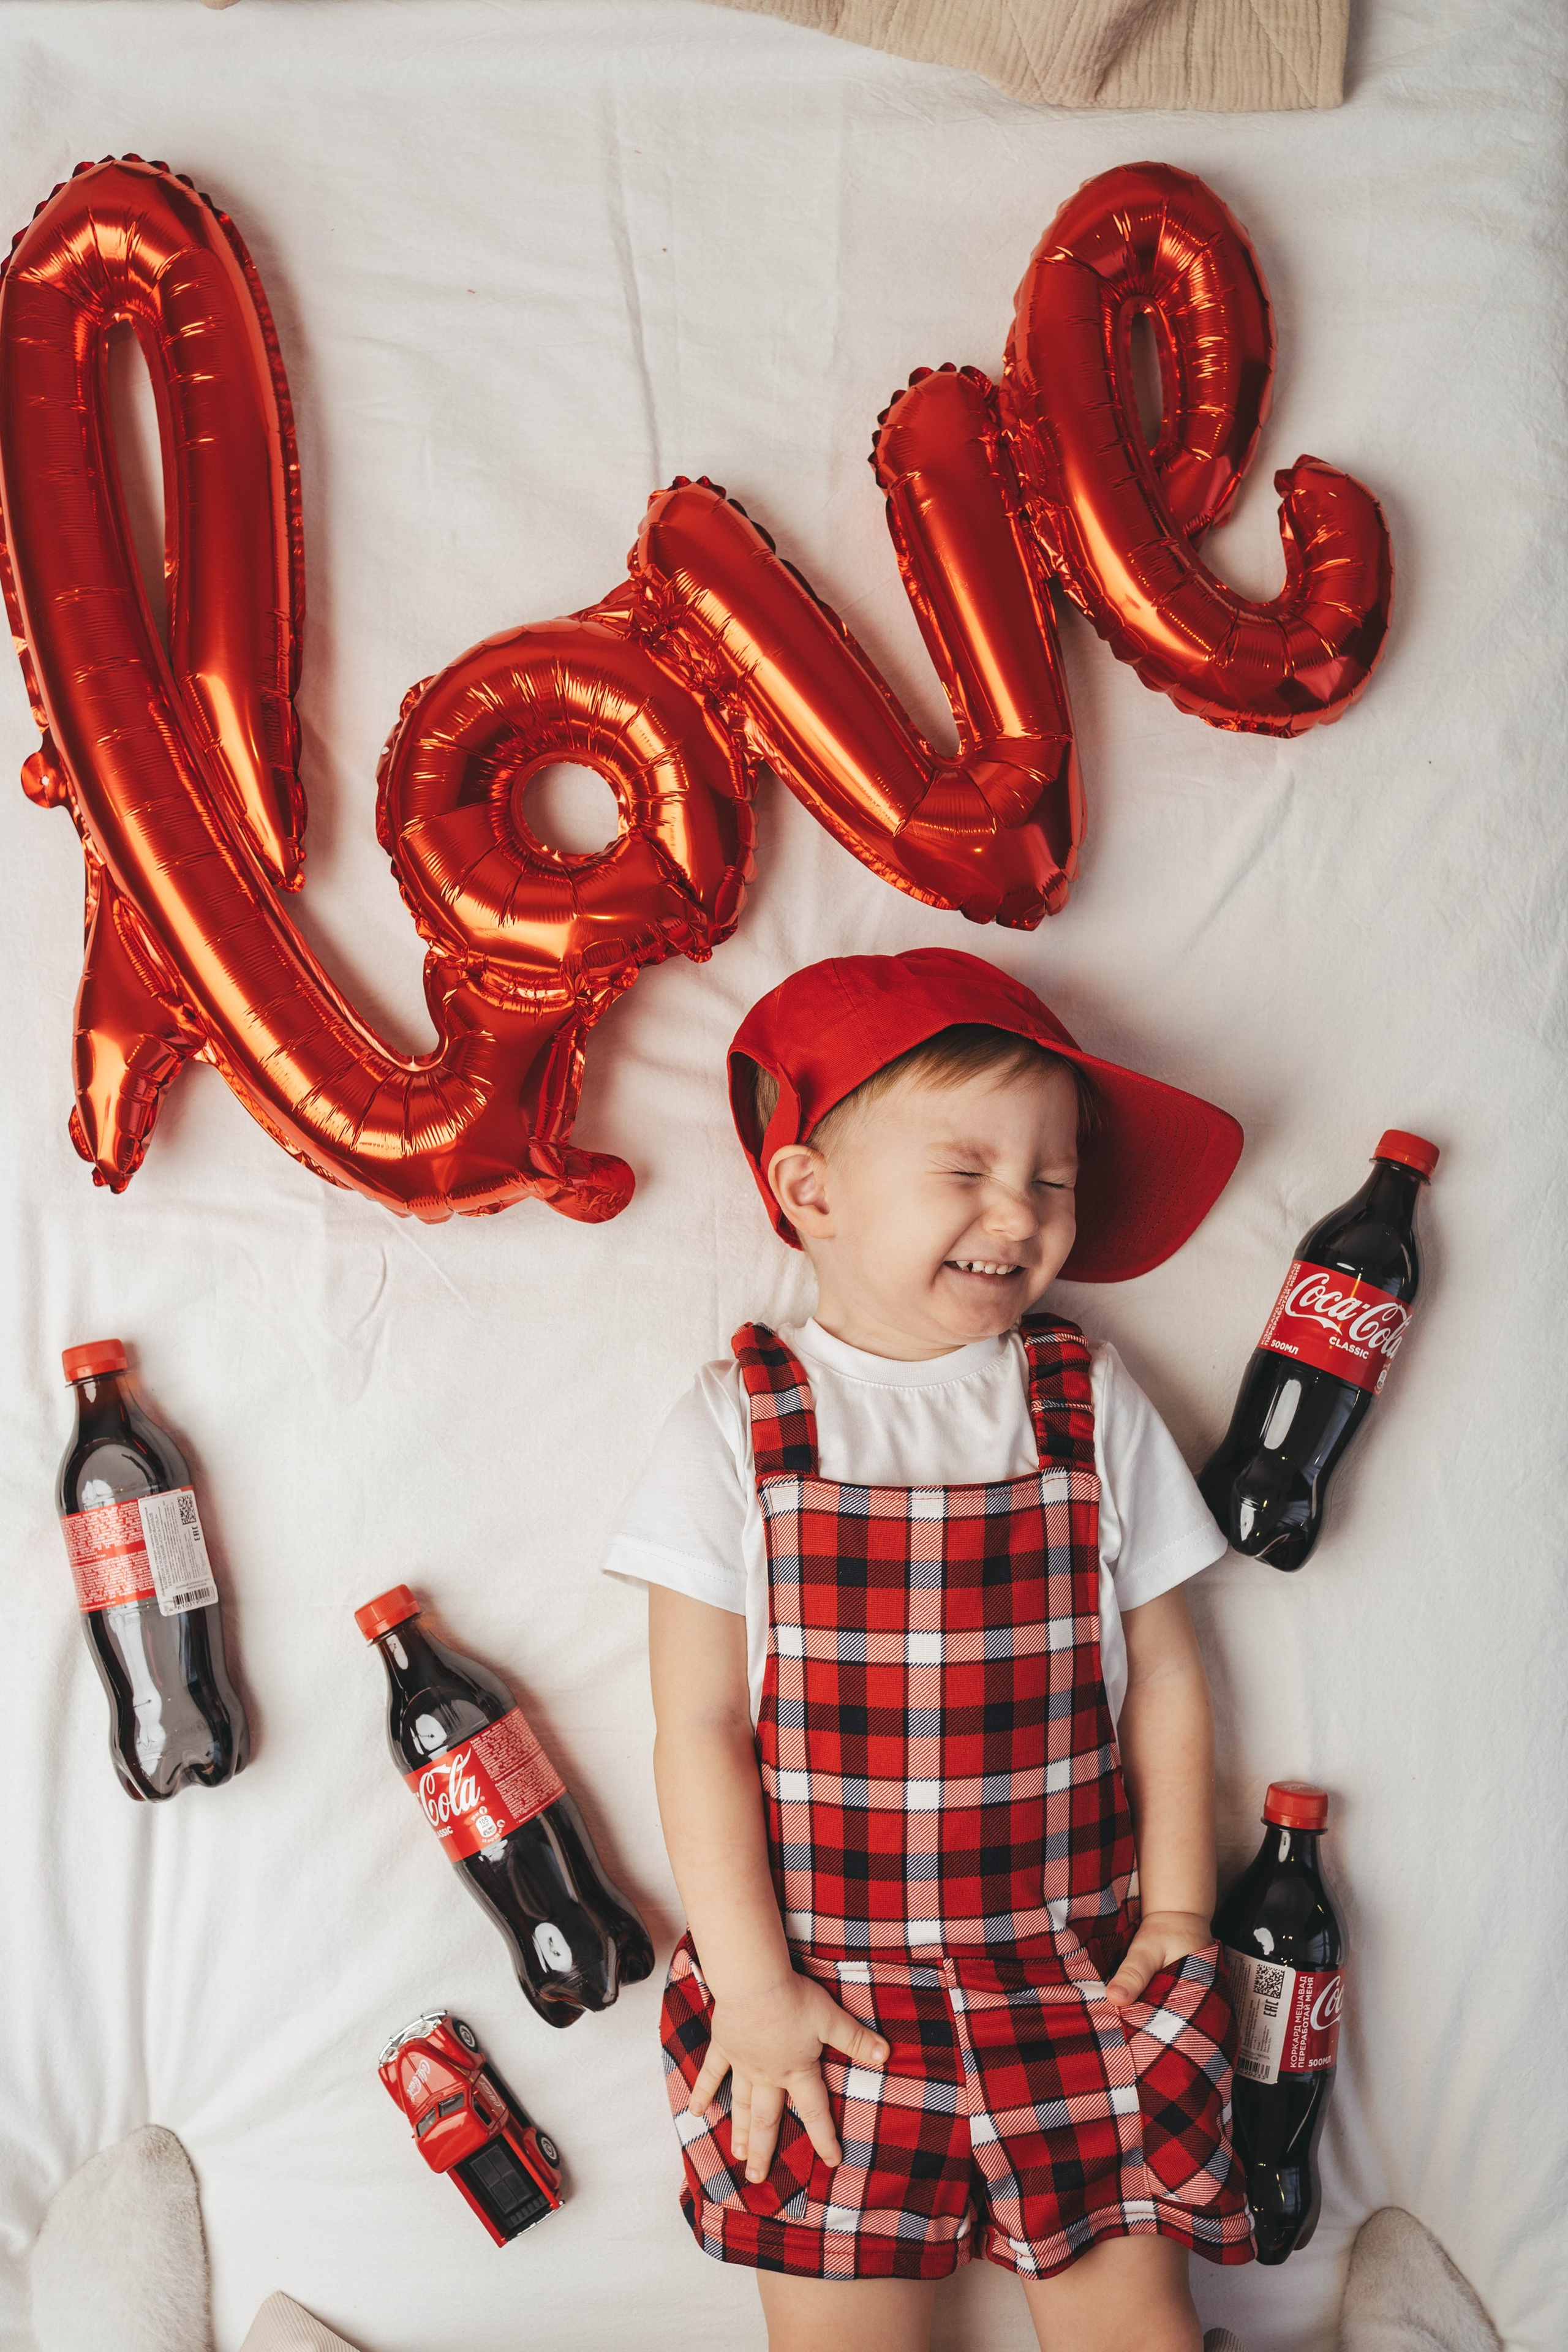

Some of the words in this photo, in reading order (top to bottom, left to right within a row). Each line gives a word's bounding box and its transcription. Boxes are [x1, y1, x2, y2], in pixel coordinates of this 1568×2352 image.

[1261, 1306, 1280, 1345] КОРКАРД
[1277, 1262, 1298, 1305] МЕШАВАД
[1264, 1288, 1291, 1346] ПЕРЕРАБОТАЙ
[1289, 1264, 1302, 1287] МЕНЯ
[1271, 1340, 1299, 1355] 500МЛ
[1329, 1336, 1370, 1359] CLASSIC
[479, 1817, 489, 1825] 105
[1295, 1976, 1308, 2022] МЕШАВАД
[1297, 2004, 1311, 2068] ПЕРЕРАБОТАЙ
[1305, 1977, 1314, 2001] МЕНЯ
[1290, 2025, 1302, 2068] КОРКАРД
[1308, 2055, 1332, 2067] 500МЛ
